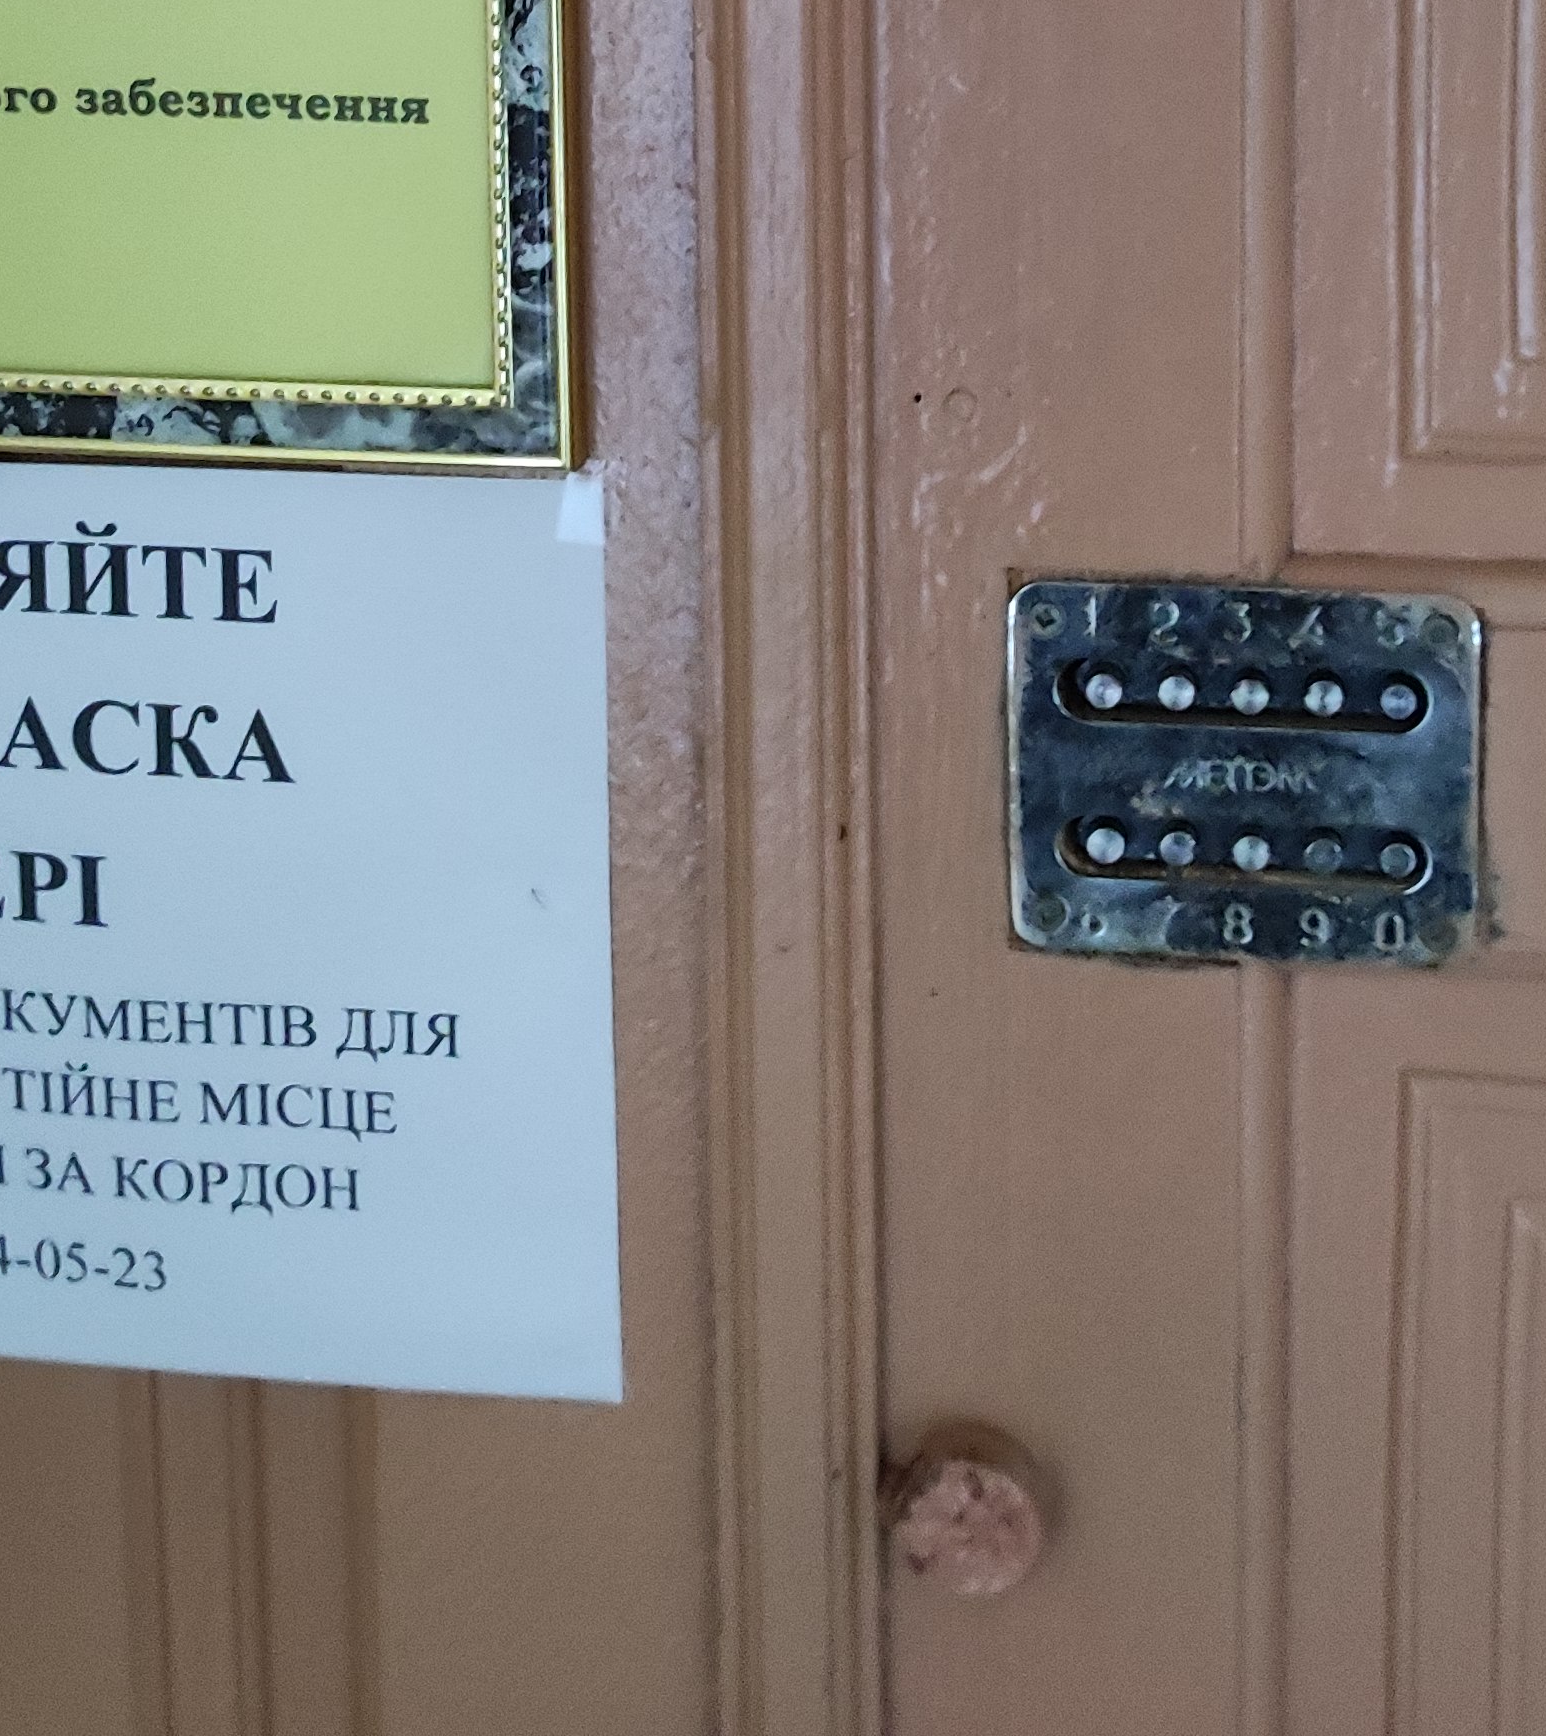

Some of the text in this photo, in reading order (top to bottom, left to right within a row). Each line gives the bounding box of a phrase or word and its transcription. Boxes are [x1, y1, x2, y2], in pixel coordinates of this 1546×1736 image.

[74, 76, 430, 125] забезпечення
[1222, 902, 1254, 945] 8
[1298, 906, 1332, 947] 9
[334, 1007, 459, 1063] ДЛЯ
[199, 1081, 398, 1143] МІСЦЕ
[25, 1147, 95, 1196] ЗА
[113, 1156, 360, 1216] КОРДОН
